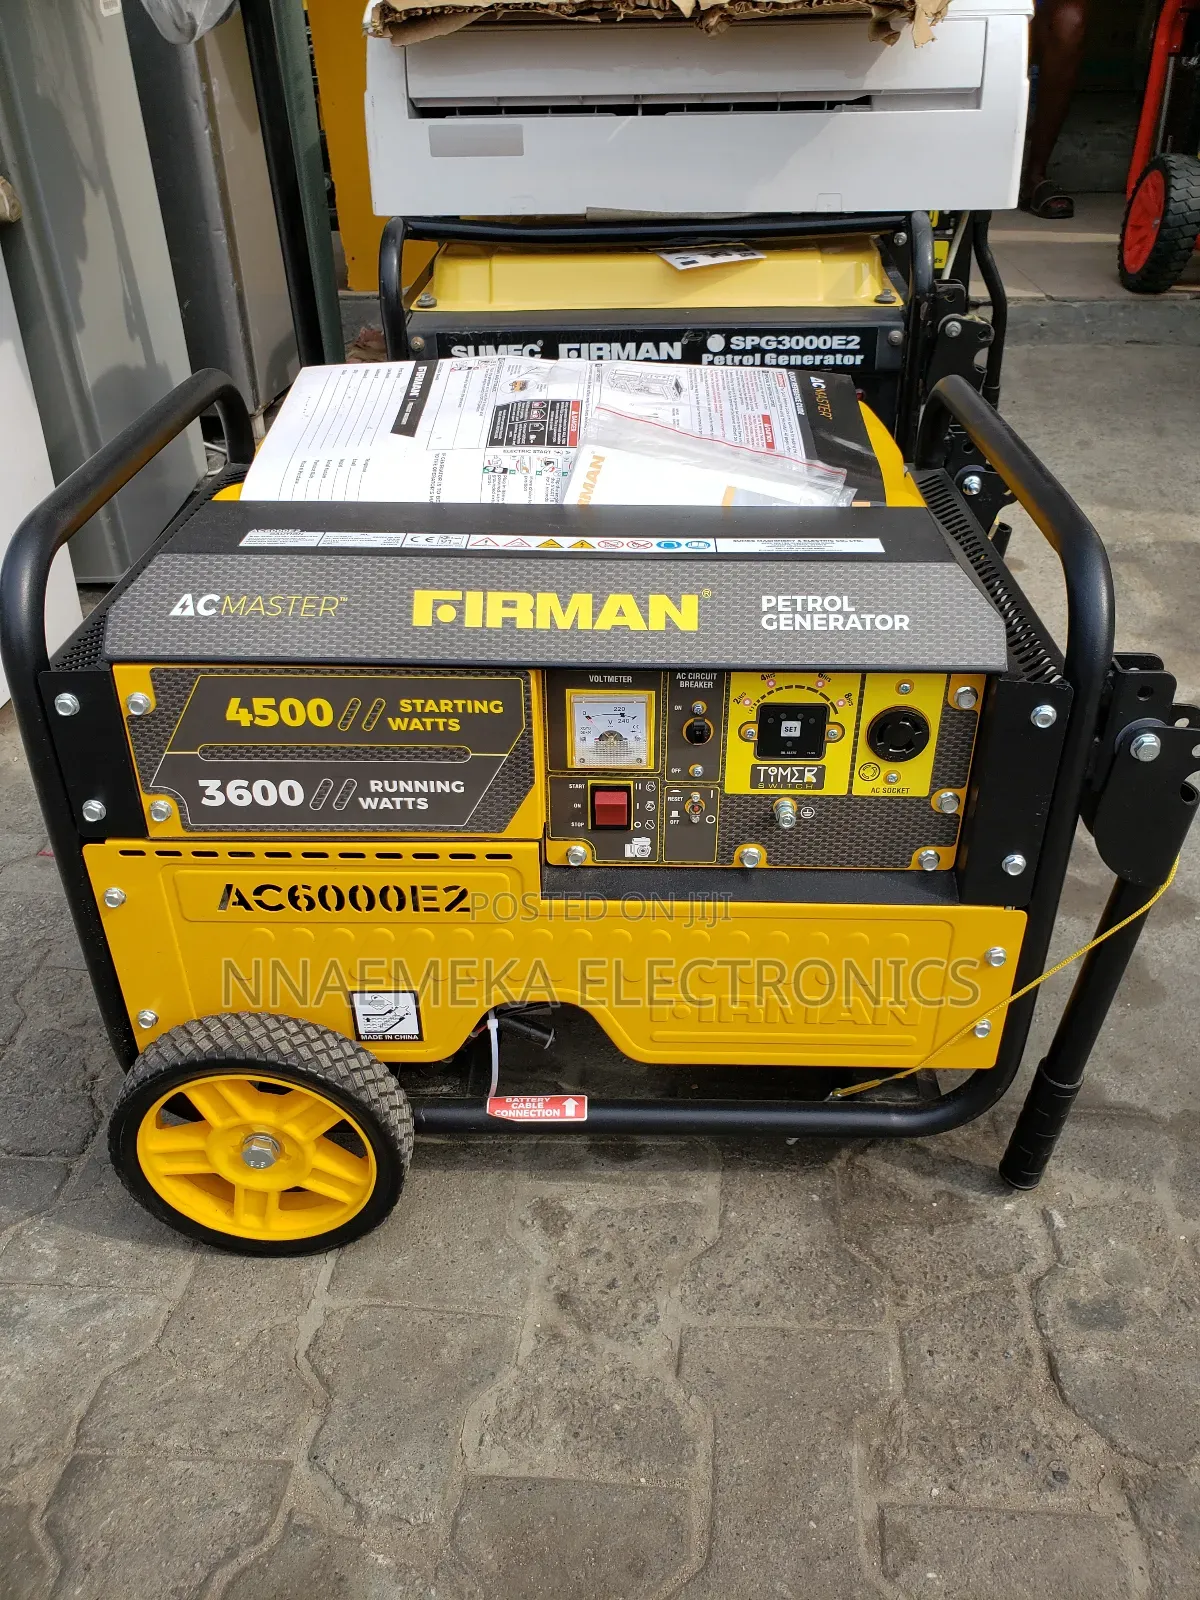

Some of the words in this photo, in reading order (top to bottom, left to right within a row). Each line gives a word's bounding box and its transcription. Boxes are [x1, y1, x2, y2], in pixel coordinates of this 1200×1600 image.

[730, 335, 861, 351] SPG3000E2
[559, 342, 682, 362] FIRMAN
[701, 351, 762, 366] Petrol
[764, 352, 864, 368] Generator
[760, 595, 855, 612] PETROL
[760, 614, 910, 631] GENERATOR
[588, 675, 633, 684] VOLTMETER
[676, 672, 687, 680] AC
[688, 672, 717, 680] CIRCUIT
[679, 681, 713, 689] BREAKER
[224, 697, 334, 728] 4500
[399, 699, 504, 715] STARTING
[387, 717, 461, 732] WATTS
[197, 779, 305, 807] 3600
[369, 780, 465, 794] RUNNING
[882, 787, 911, 795] SOCKET
[358, 797, 429, 811] WATTS
[217, 884, 471, 913] AC6000E2
[650, 993, 923, 1026] FIRMAN
[493, 1109, 561, 1118] CONNECTION
